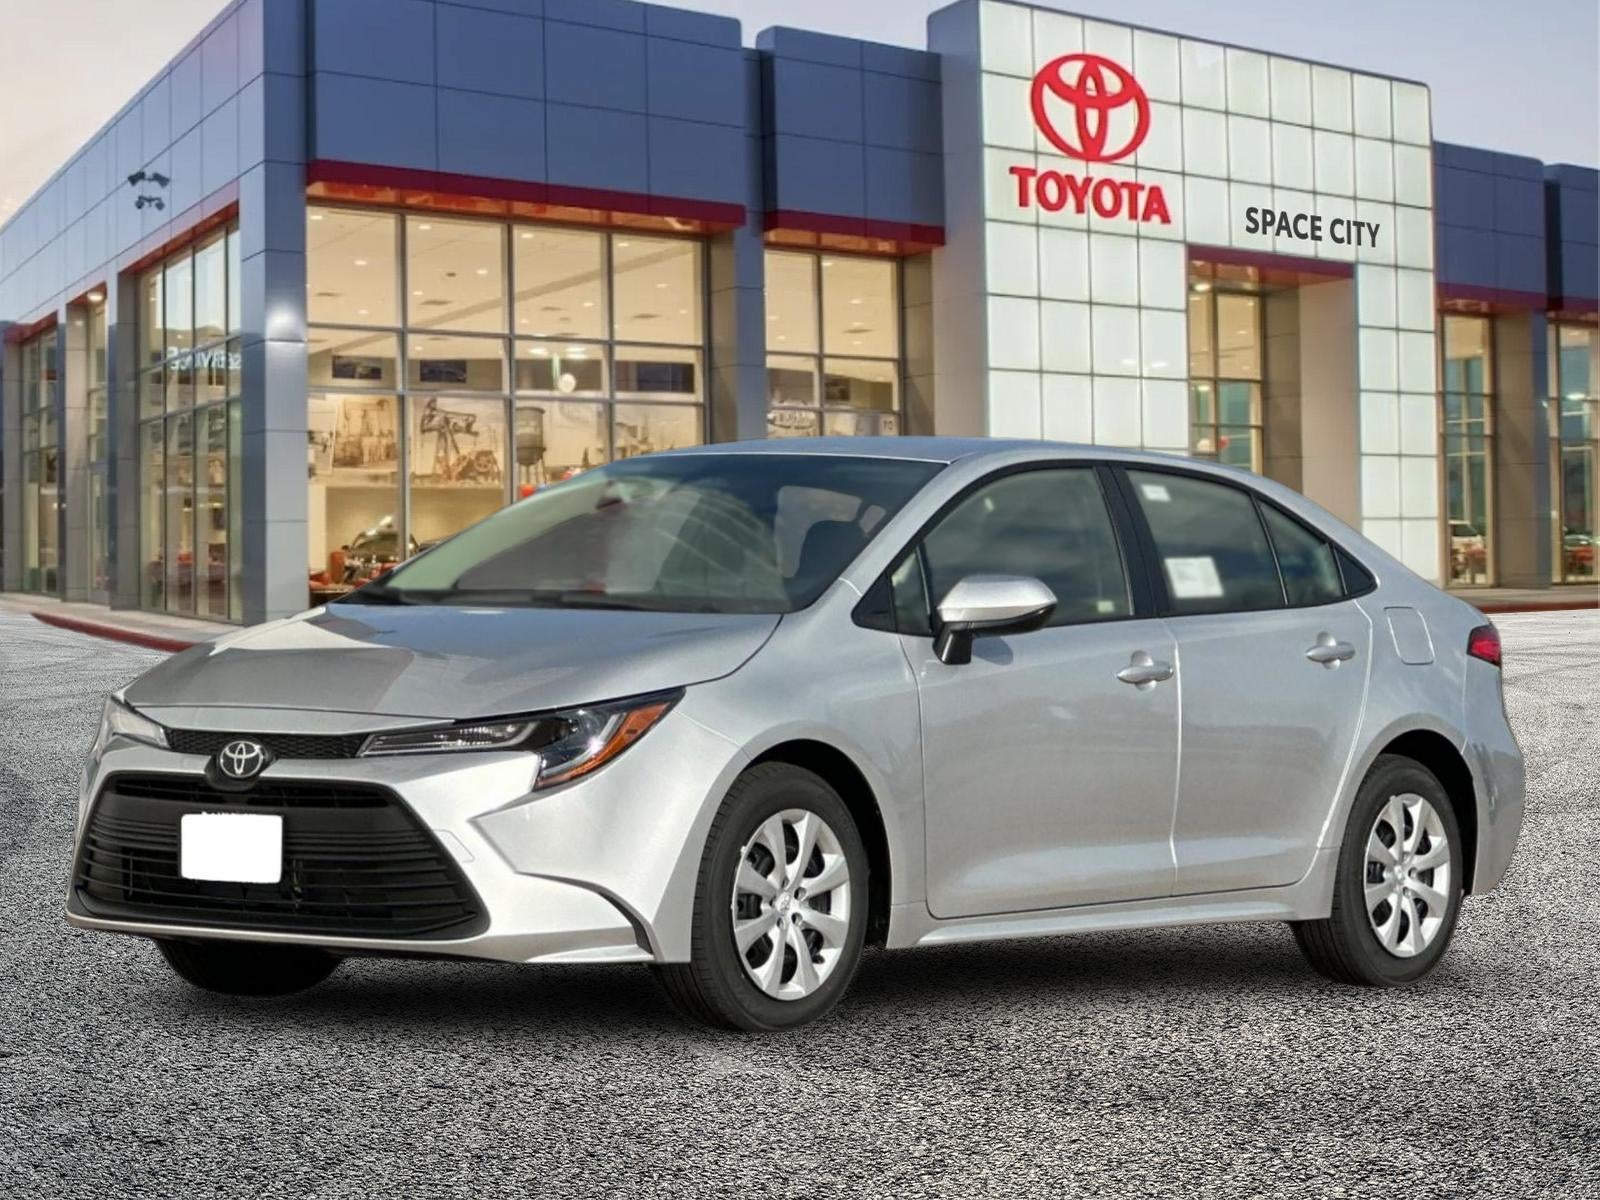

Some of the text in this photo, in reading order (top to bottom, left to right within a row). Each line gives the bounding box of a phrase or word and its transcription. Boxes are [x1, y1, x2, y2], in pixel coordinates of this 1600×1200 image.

[1009, 166, 1171, 224] TOYOTA
[1246, 207, 1380, 247] SPACE CITY
